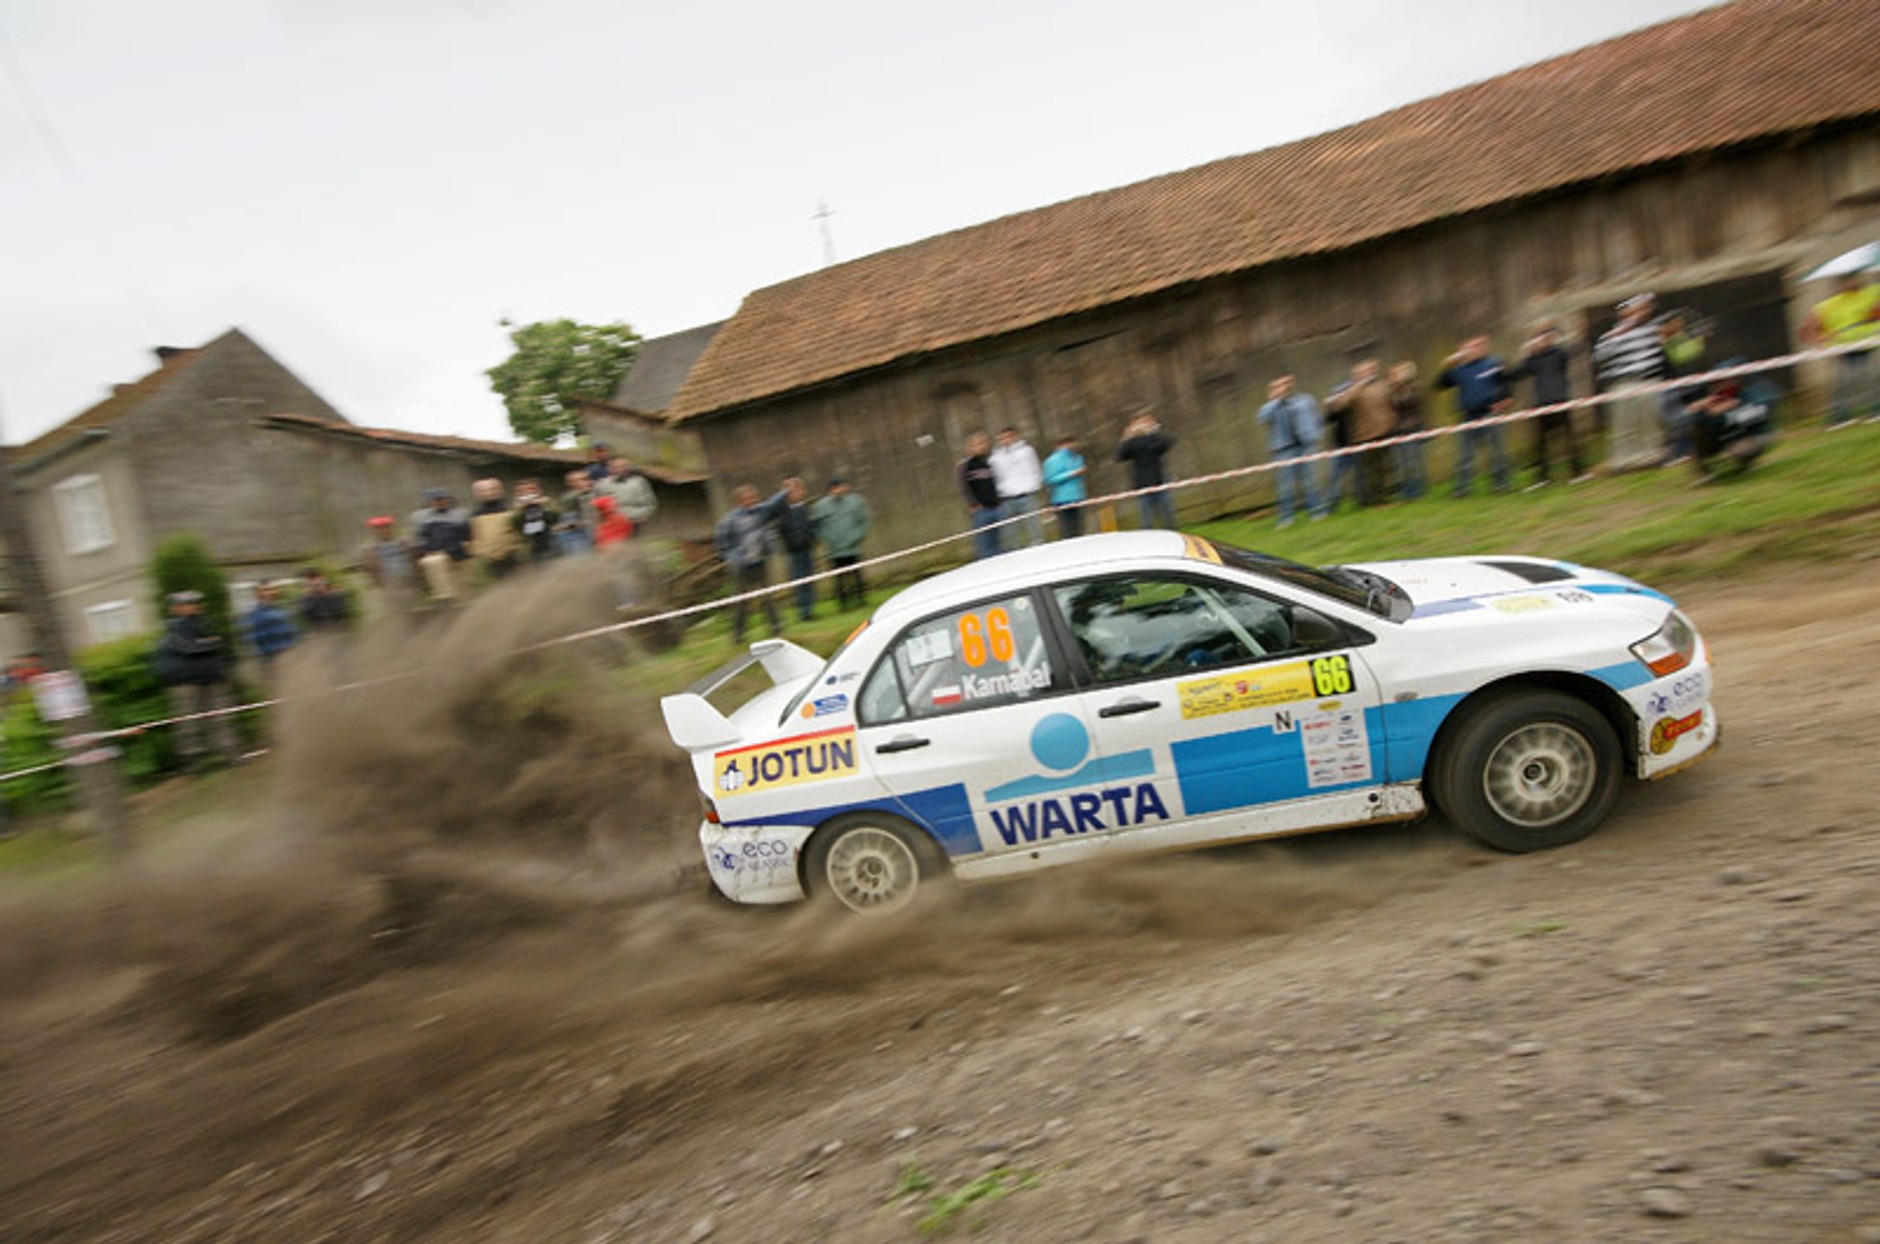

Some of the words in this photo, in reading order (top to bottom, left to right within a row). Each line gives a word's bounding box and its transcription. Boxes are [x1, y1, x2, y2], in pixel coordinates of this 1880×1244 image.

[958, 606, 1015, 668] 66
[1312, 655, 1352, 695] 66
[1275, 710, 1292, 730] N
[746, 739, 855, 787] JOTUN
[989, 782, 1169, 847] WARTA
[743, 840, 788, 858] eco
